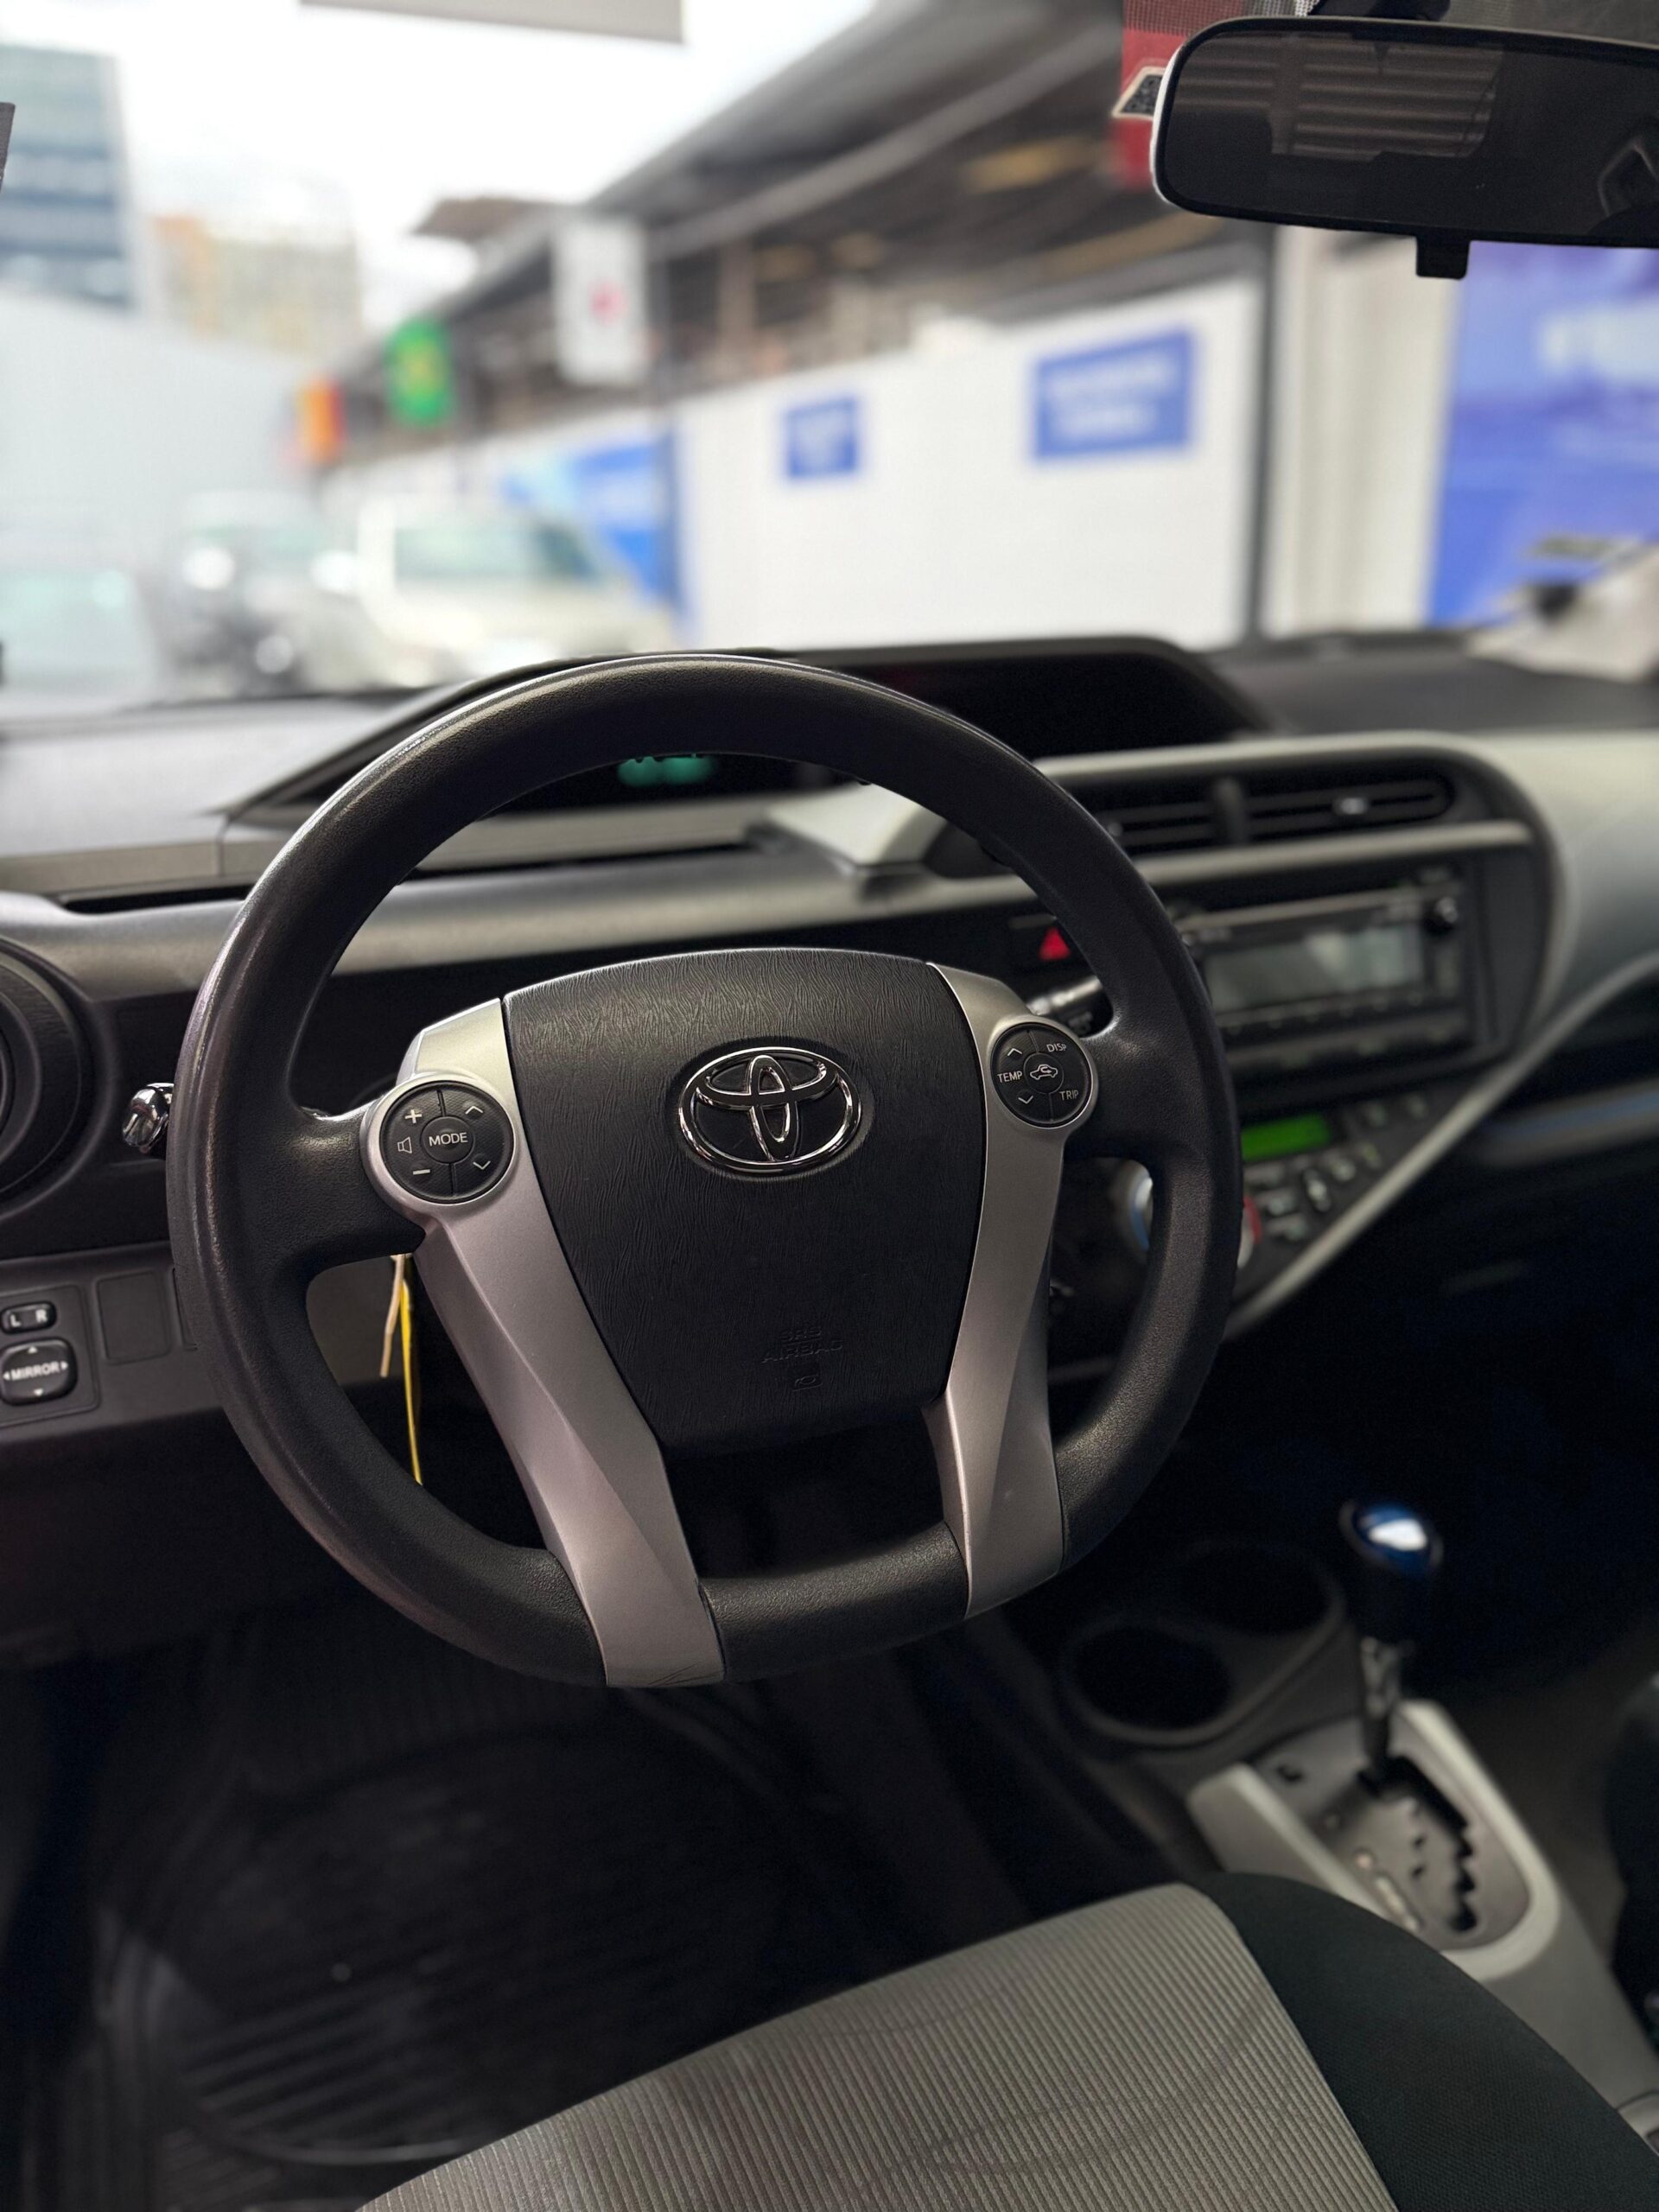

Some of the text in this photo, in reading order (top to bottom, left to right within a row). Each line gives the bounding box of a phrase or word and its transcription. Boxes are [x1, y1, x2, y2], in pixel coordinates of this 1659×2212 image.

[1046, 1043, 1067, 1052] DISP
[997, 1071, 1023, 1084] TEMP
[1058, 1090, 1079, 1101] TRIP
[428, 1132, 468, 1147] MODE
[10, 1309, 48, 1327] L R
[10, 1361, 60, 1381] MIRROR
